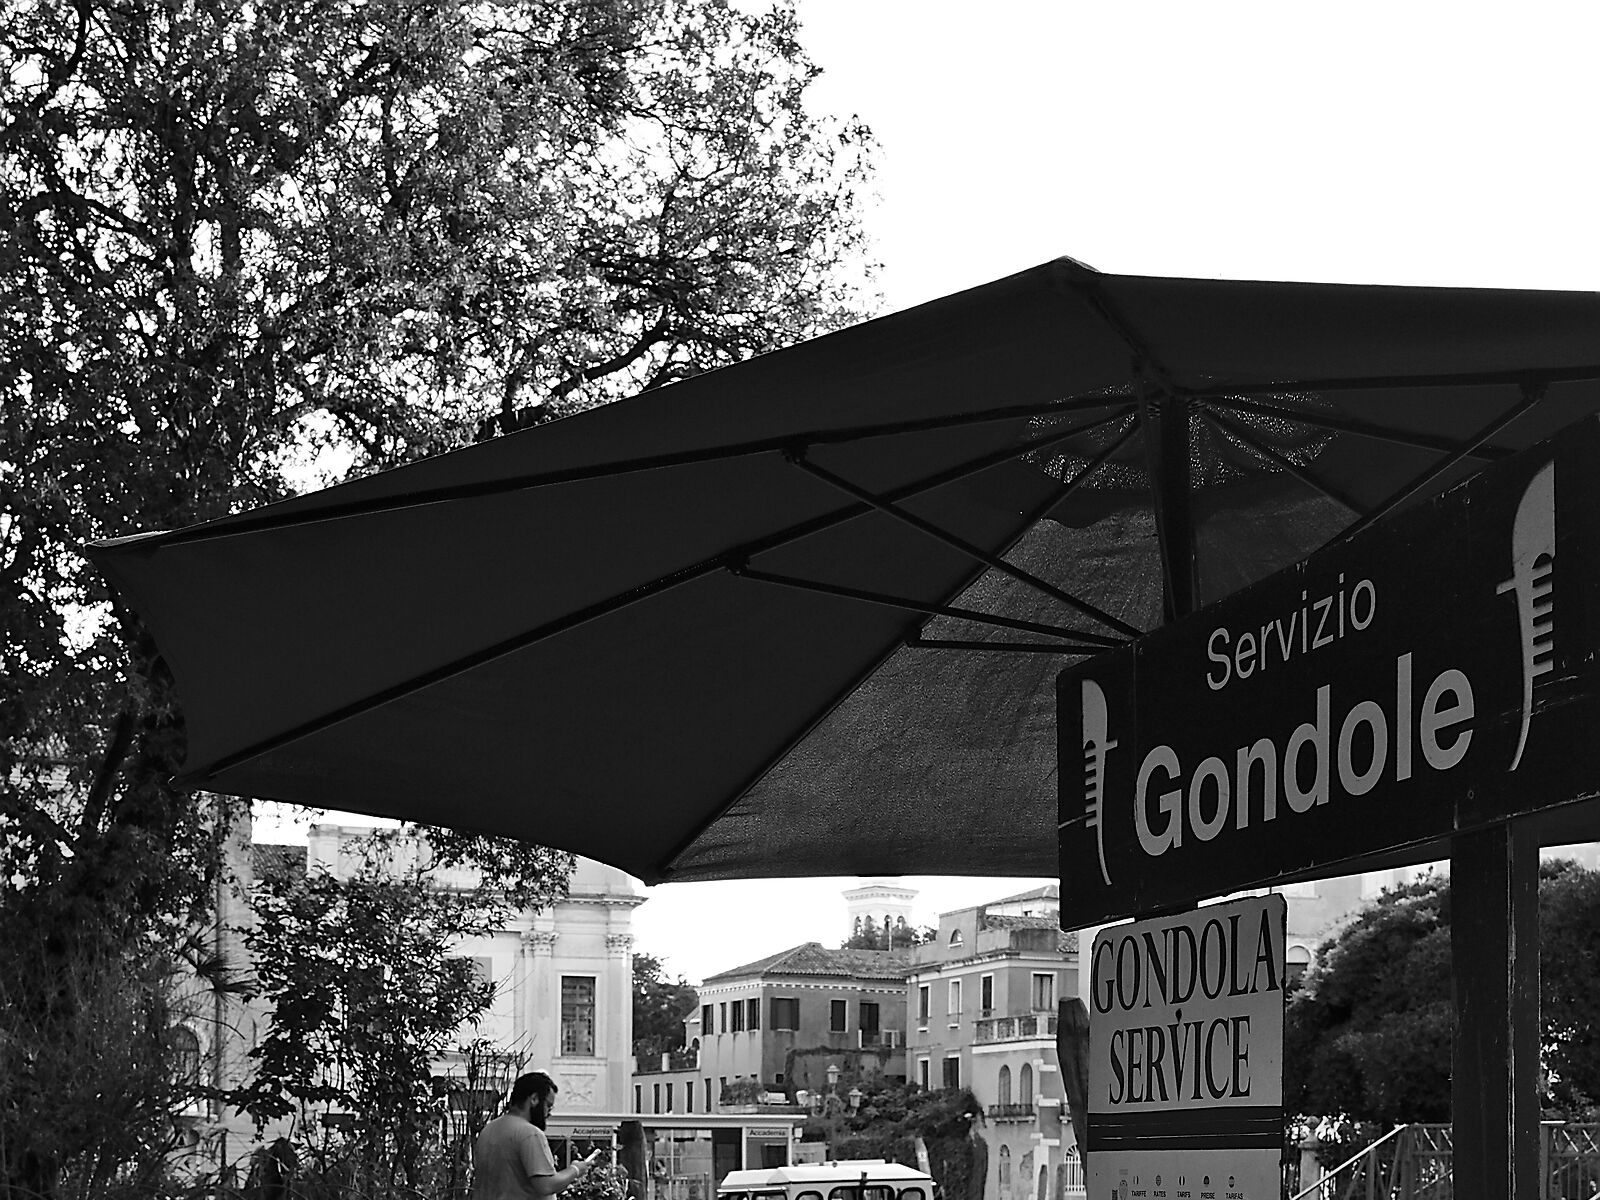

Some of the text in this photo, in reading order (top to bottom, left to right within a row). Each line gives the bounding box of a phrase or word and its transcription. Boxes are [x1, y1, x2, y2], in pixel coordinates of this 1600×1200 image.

[1206, 573, 1376, 691] Servizio
[1135, 652, 1475, 857] Gondole
[1092, 908, 1280, 1014] GONDOLA
[1108, 1015, 1251, 1105] SERVICE
[572, 1127, 611, 1136] Accademia
[749, 1128, 787, 1136] Accademia
